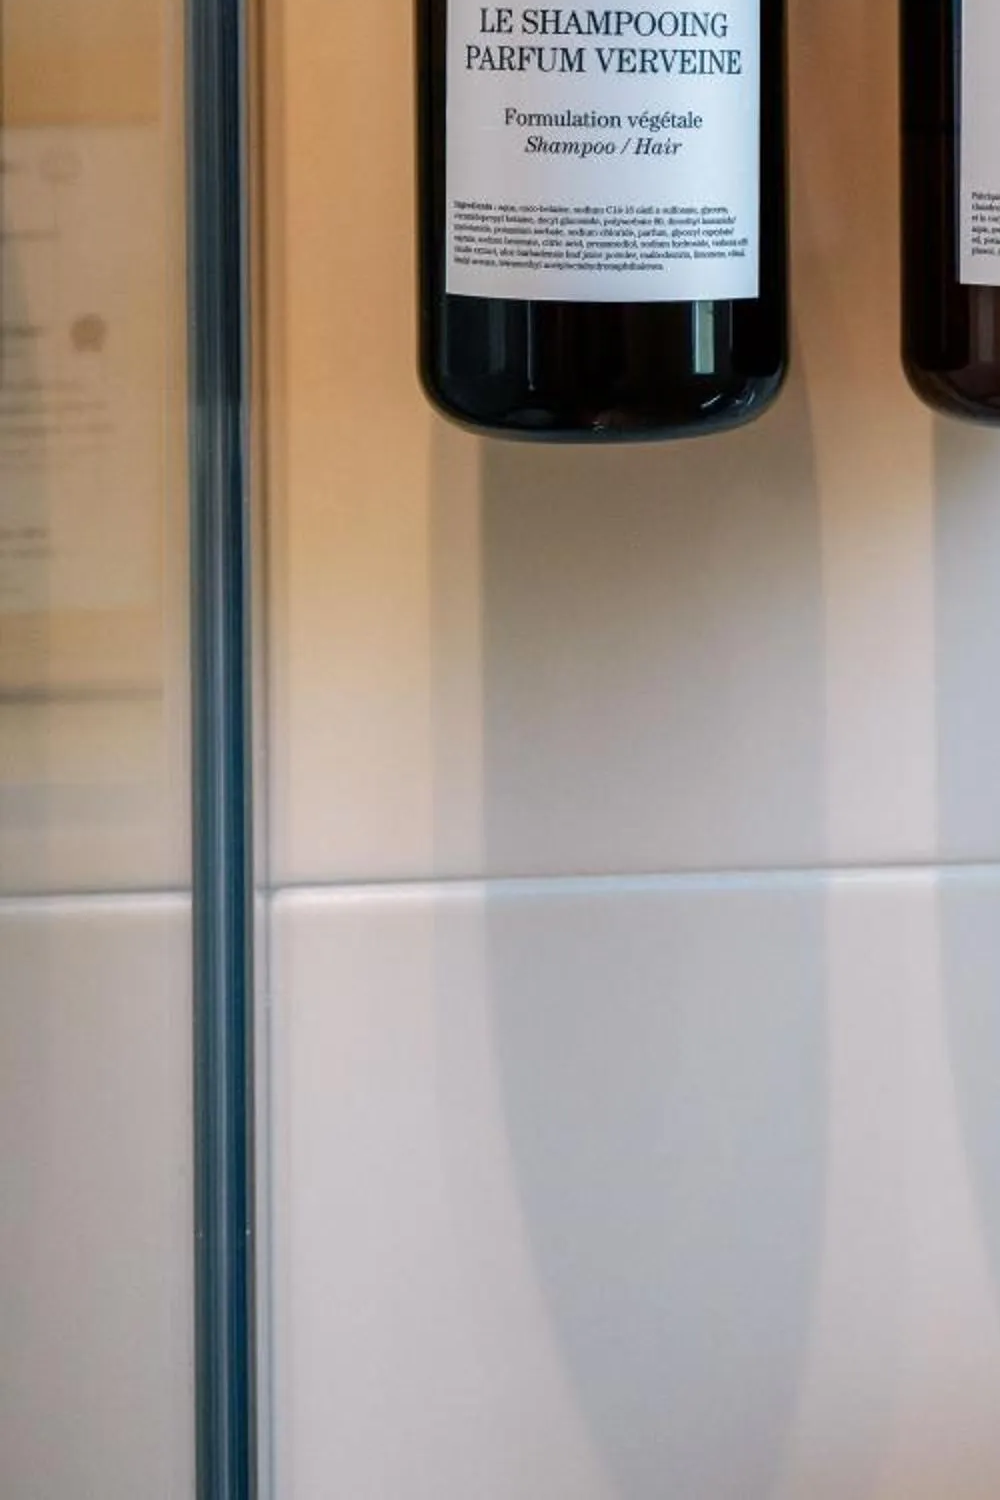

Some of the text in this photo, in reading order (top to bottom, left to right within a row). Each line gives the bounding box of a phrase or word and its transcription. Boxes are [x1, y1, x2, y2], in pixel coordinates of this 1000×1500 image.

[480, 8, 728, 38] LE SHAMPOOING
[466, 45, 742, 75] PARFUM VERVEINE
[505, 108, 703, 132] Formulation végétale
[524, 135, 616, 158] Shampoo
[634, 138, 683, 156] Hair
